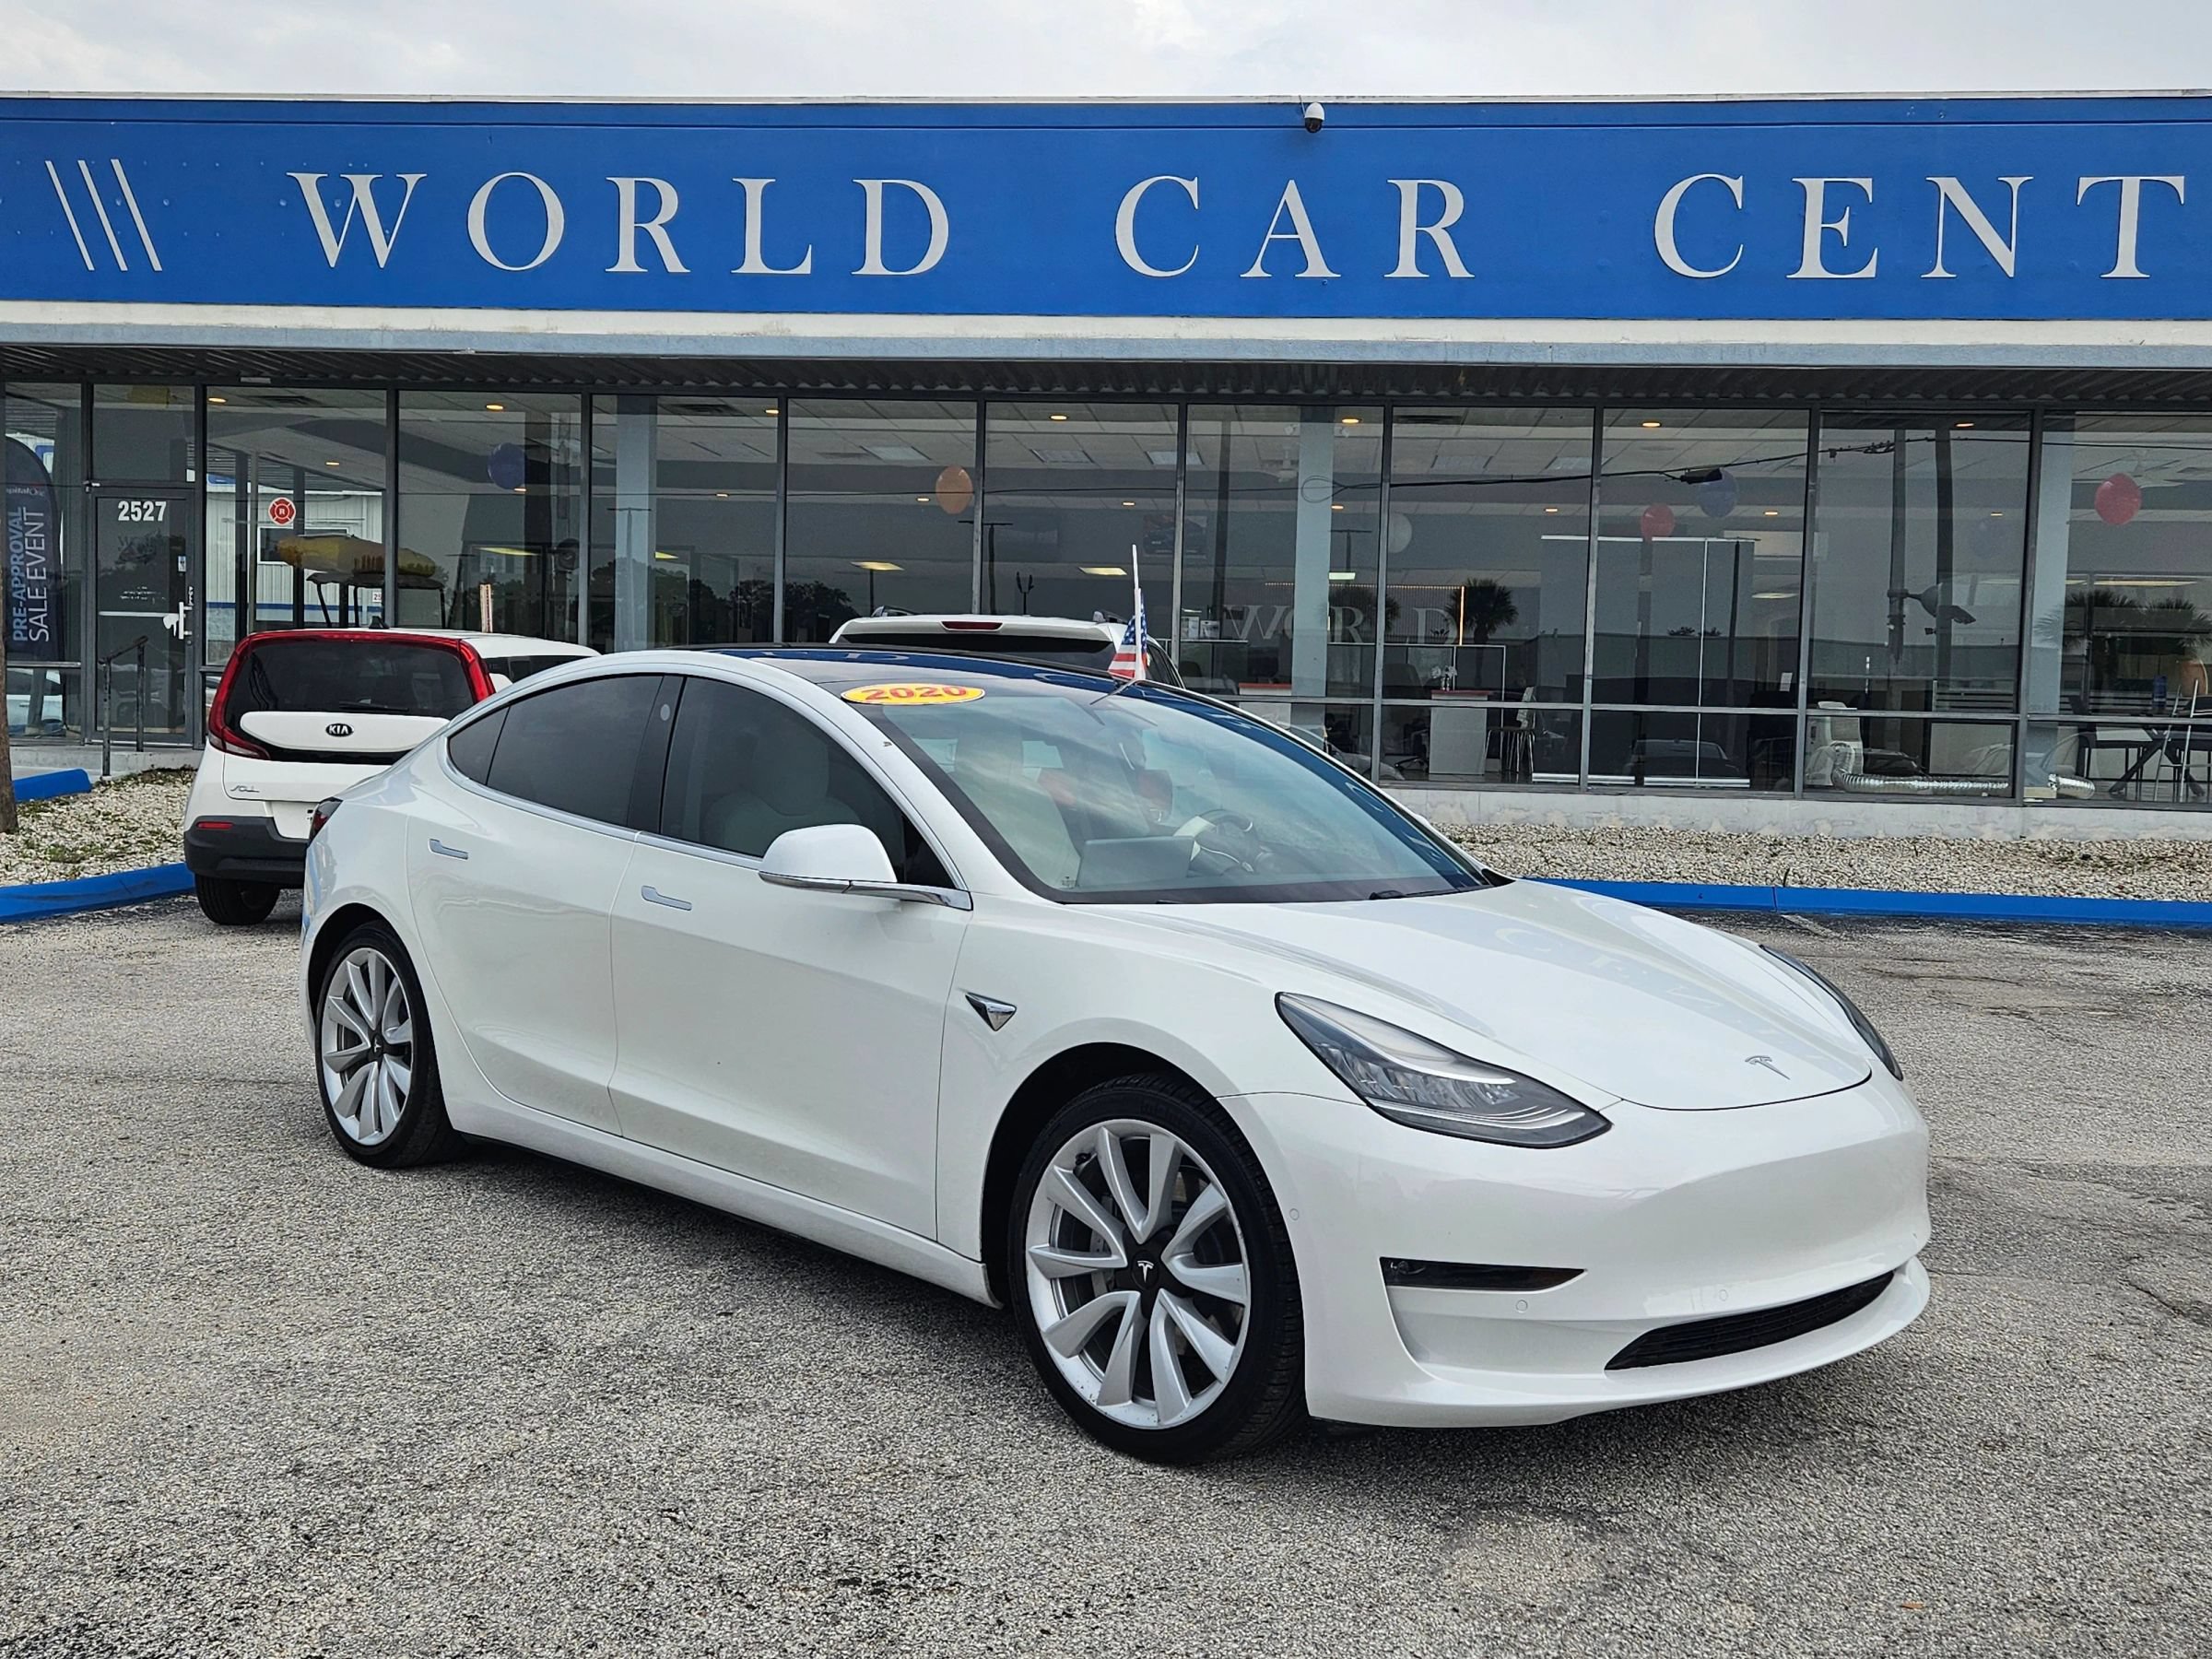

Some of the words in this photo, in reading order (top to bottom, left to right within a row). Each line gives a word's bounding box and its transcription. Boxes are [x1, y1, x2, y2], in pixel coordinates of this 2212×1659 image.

[288, 172, 948, 275] WORLD
[1116, 176, 1474, 276] CAR
[1655, 174, 2184, 277] CENT
[117, 500, 167, 522] 2527
[23, 507, 47, 580] EVENT
[9, 507, 29, 641] PRE-APPROVAL
[27, 587, 49, 642] SALE
[1223, 605, 1458, 645] WRD
[861, 686, 967, 701] 2020
[328, 724, 349, 735] KIA
